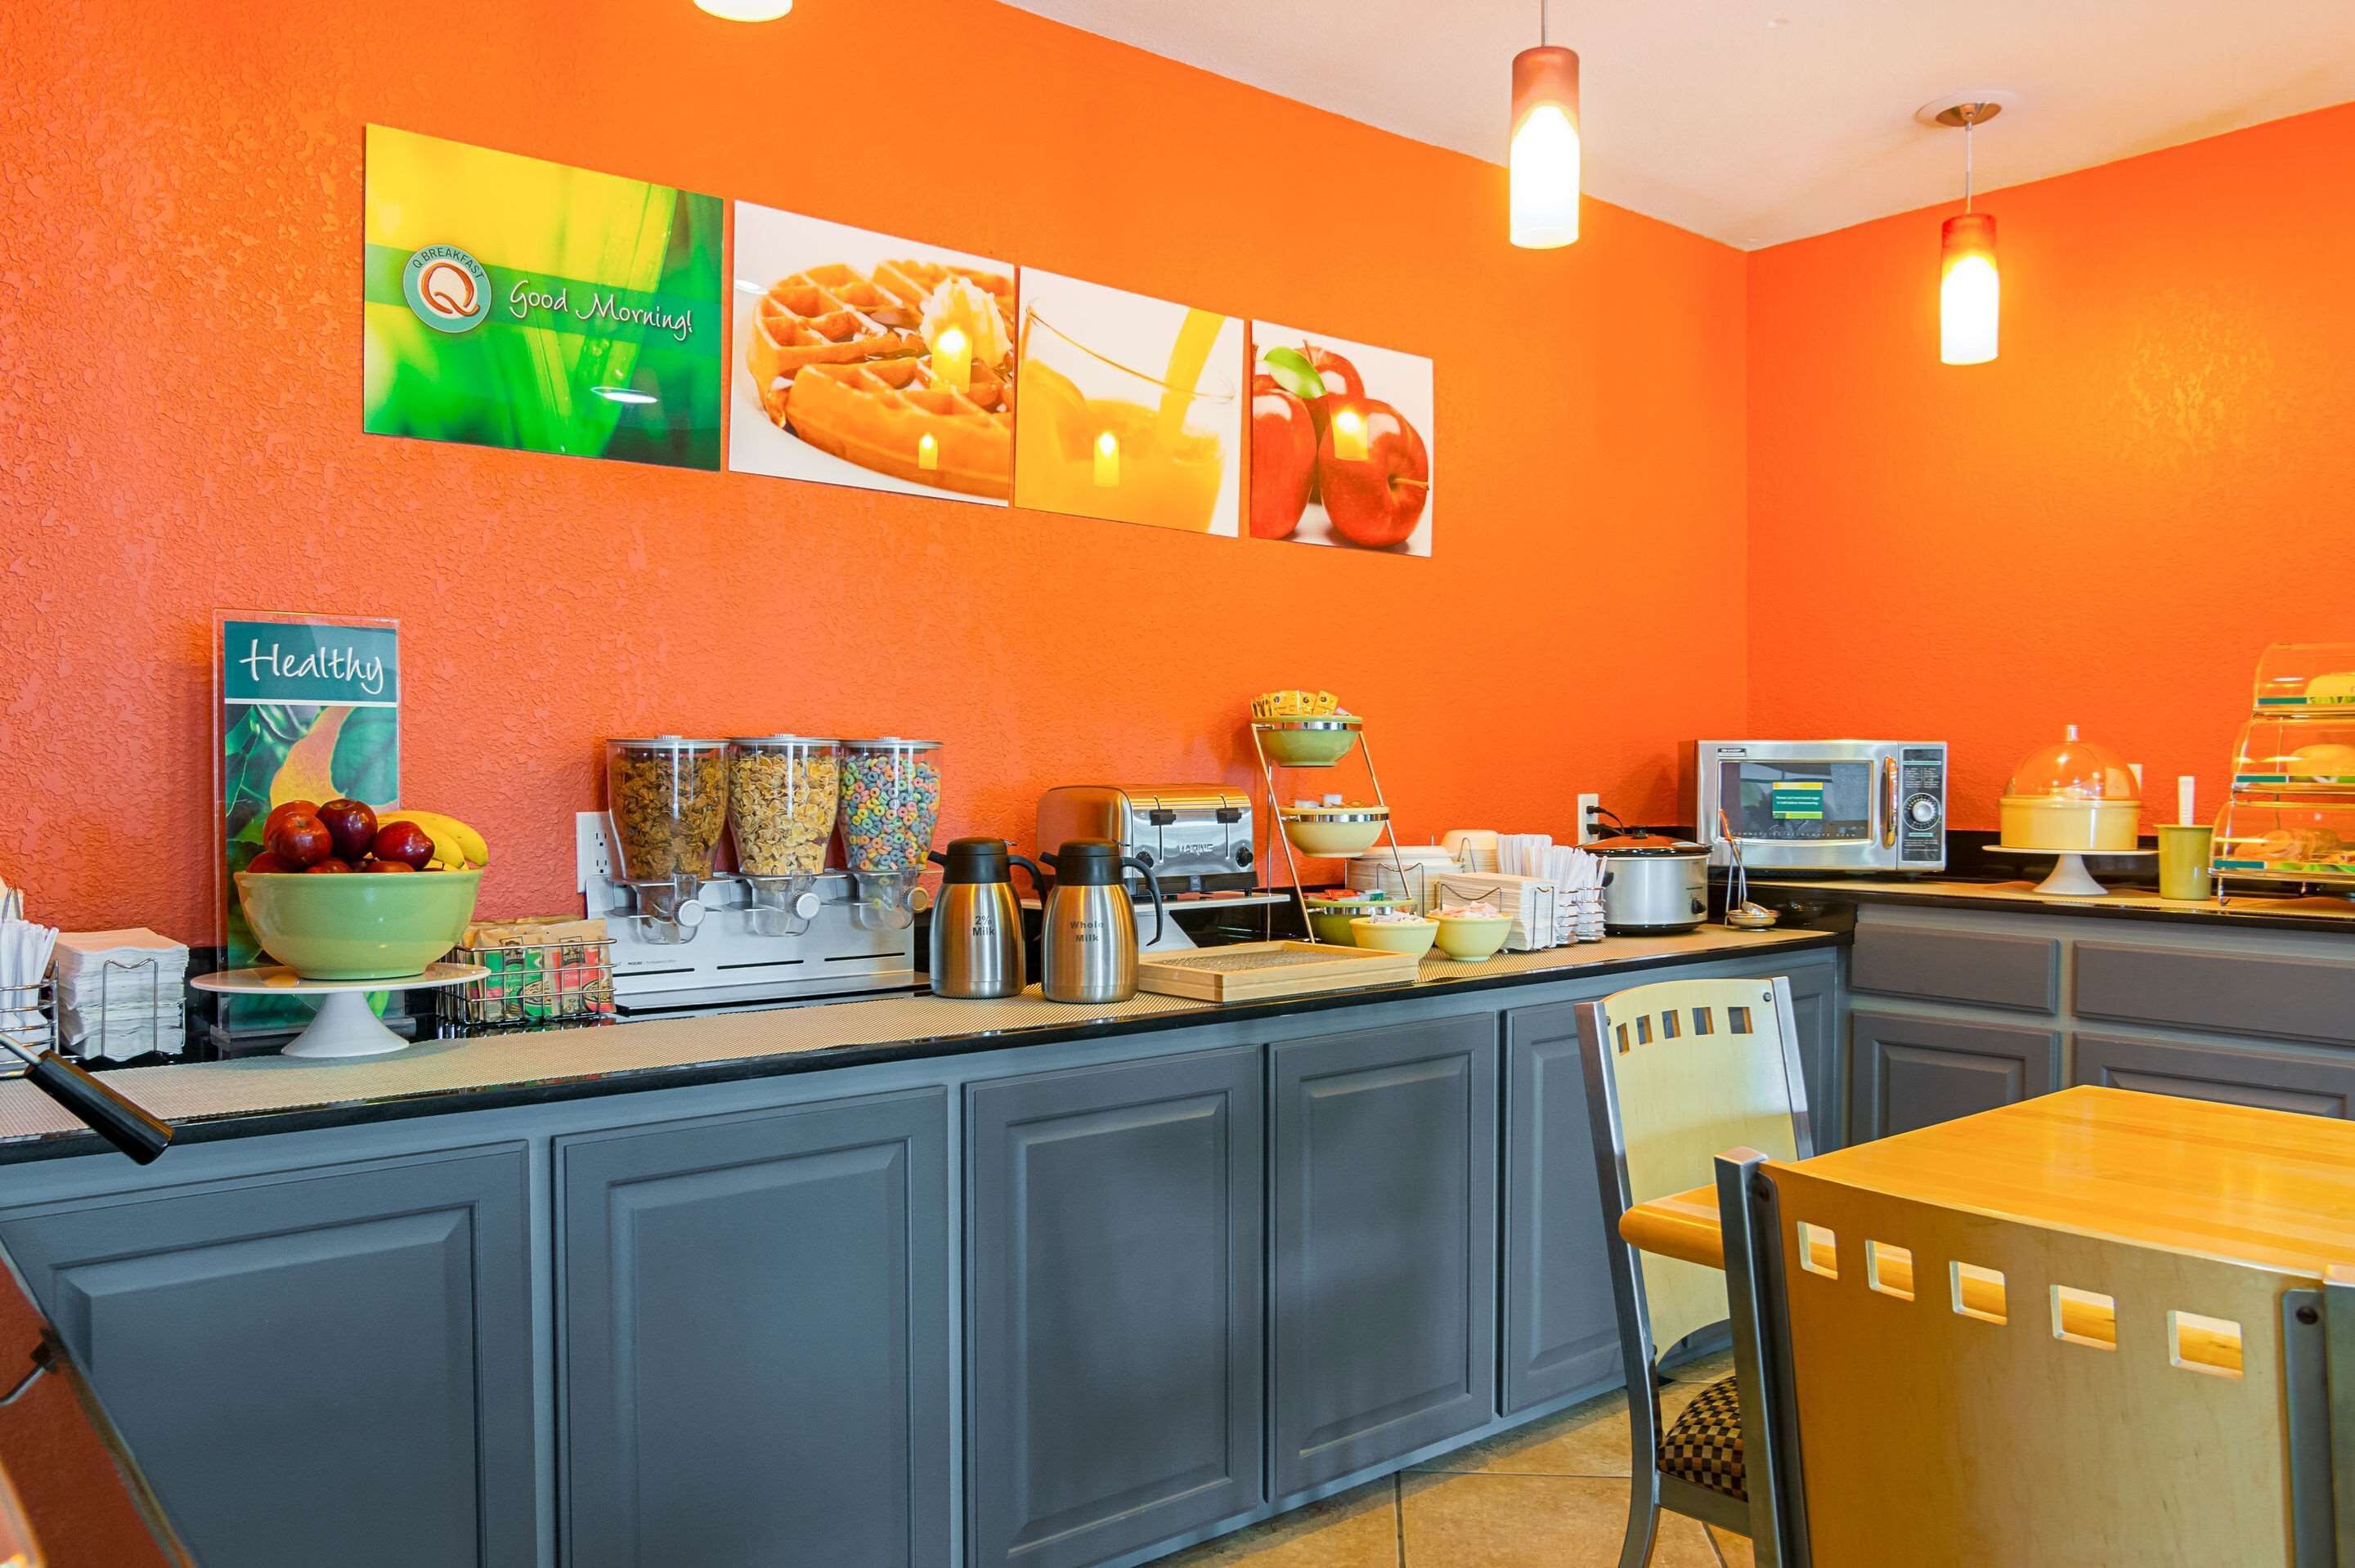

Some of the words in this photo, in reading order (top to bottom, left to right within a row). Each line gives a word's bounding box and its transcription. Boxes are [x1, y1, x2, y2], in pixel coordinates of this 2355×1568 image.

[412, 259, 423, 269] Q
[421, 247, 485, 279] BREAKFAST
[421, 262, 480, 316] Q
[509, 280, 568, 319] Good
[575, 293, 693, 342] Morning!
[238, 638, 384, 695] Healthy
[975, 916, 992, 925] 2%
[1070, 921, 1104, 930] Whole
[973, 927, 995, 936] Milk
[1075, 934, 1099, 943] Milk
